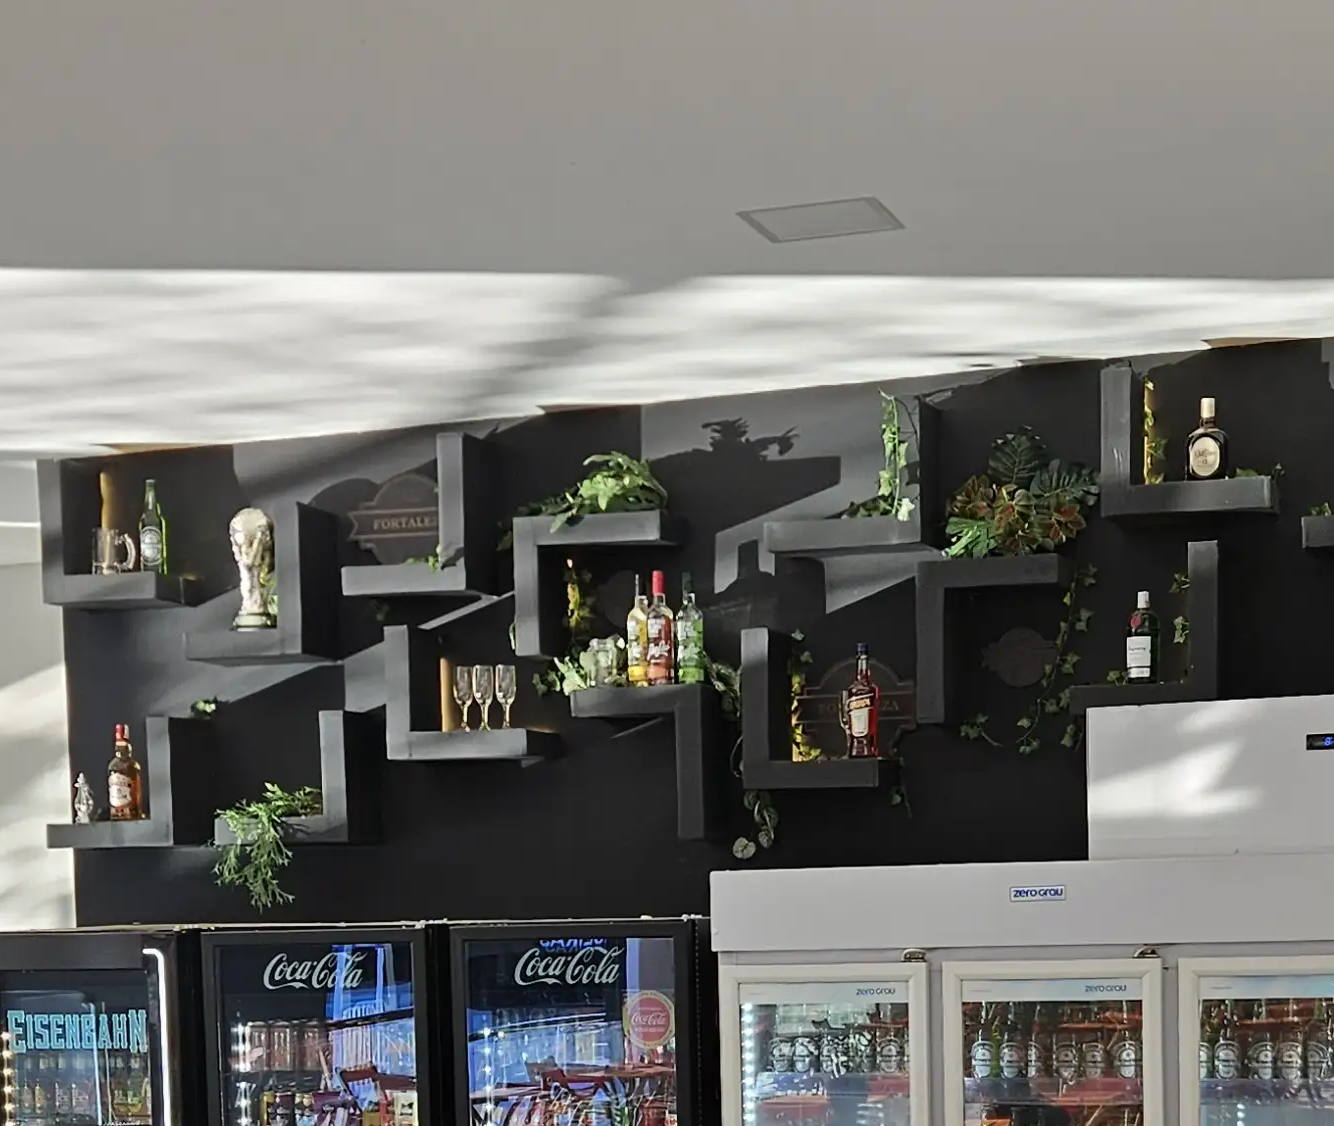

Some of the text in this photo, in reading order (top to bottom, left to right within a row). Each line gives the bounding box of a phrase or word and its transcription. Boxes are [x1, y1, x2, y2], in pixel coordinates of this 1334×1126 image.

[373, 516, 437, 531] FORTALE
[1013, 888, 1037, 898] zero
[263, 952, 367, 989] Coca-Cola
[514, 947, 624, 986] Coca-Cola
[7, 1009, 148, 1053] EISENBAHN
